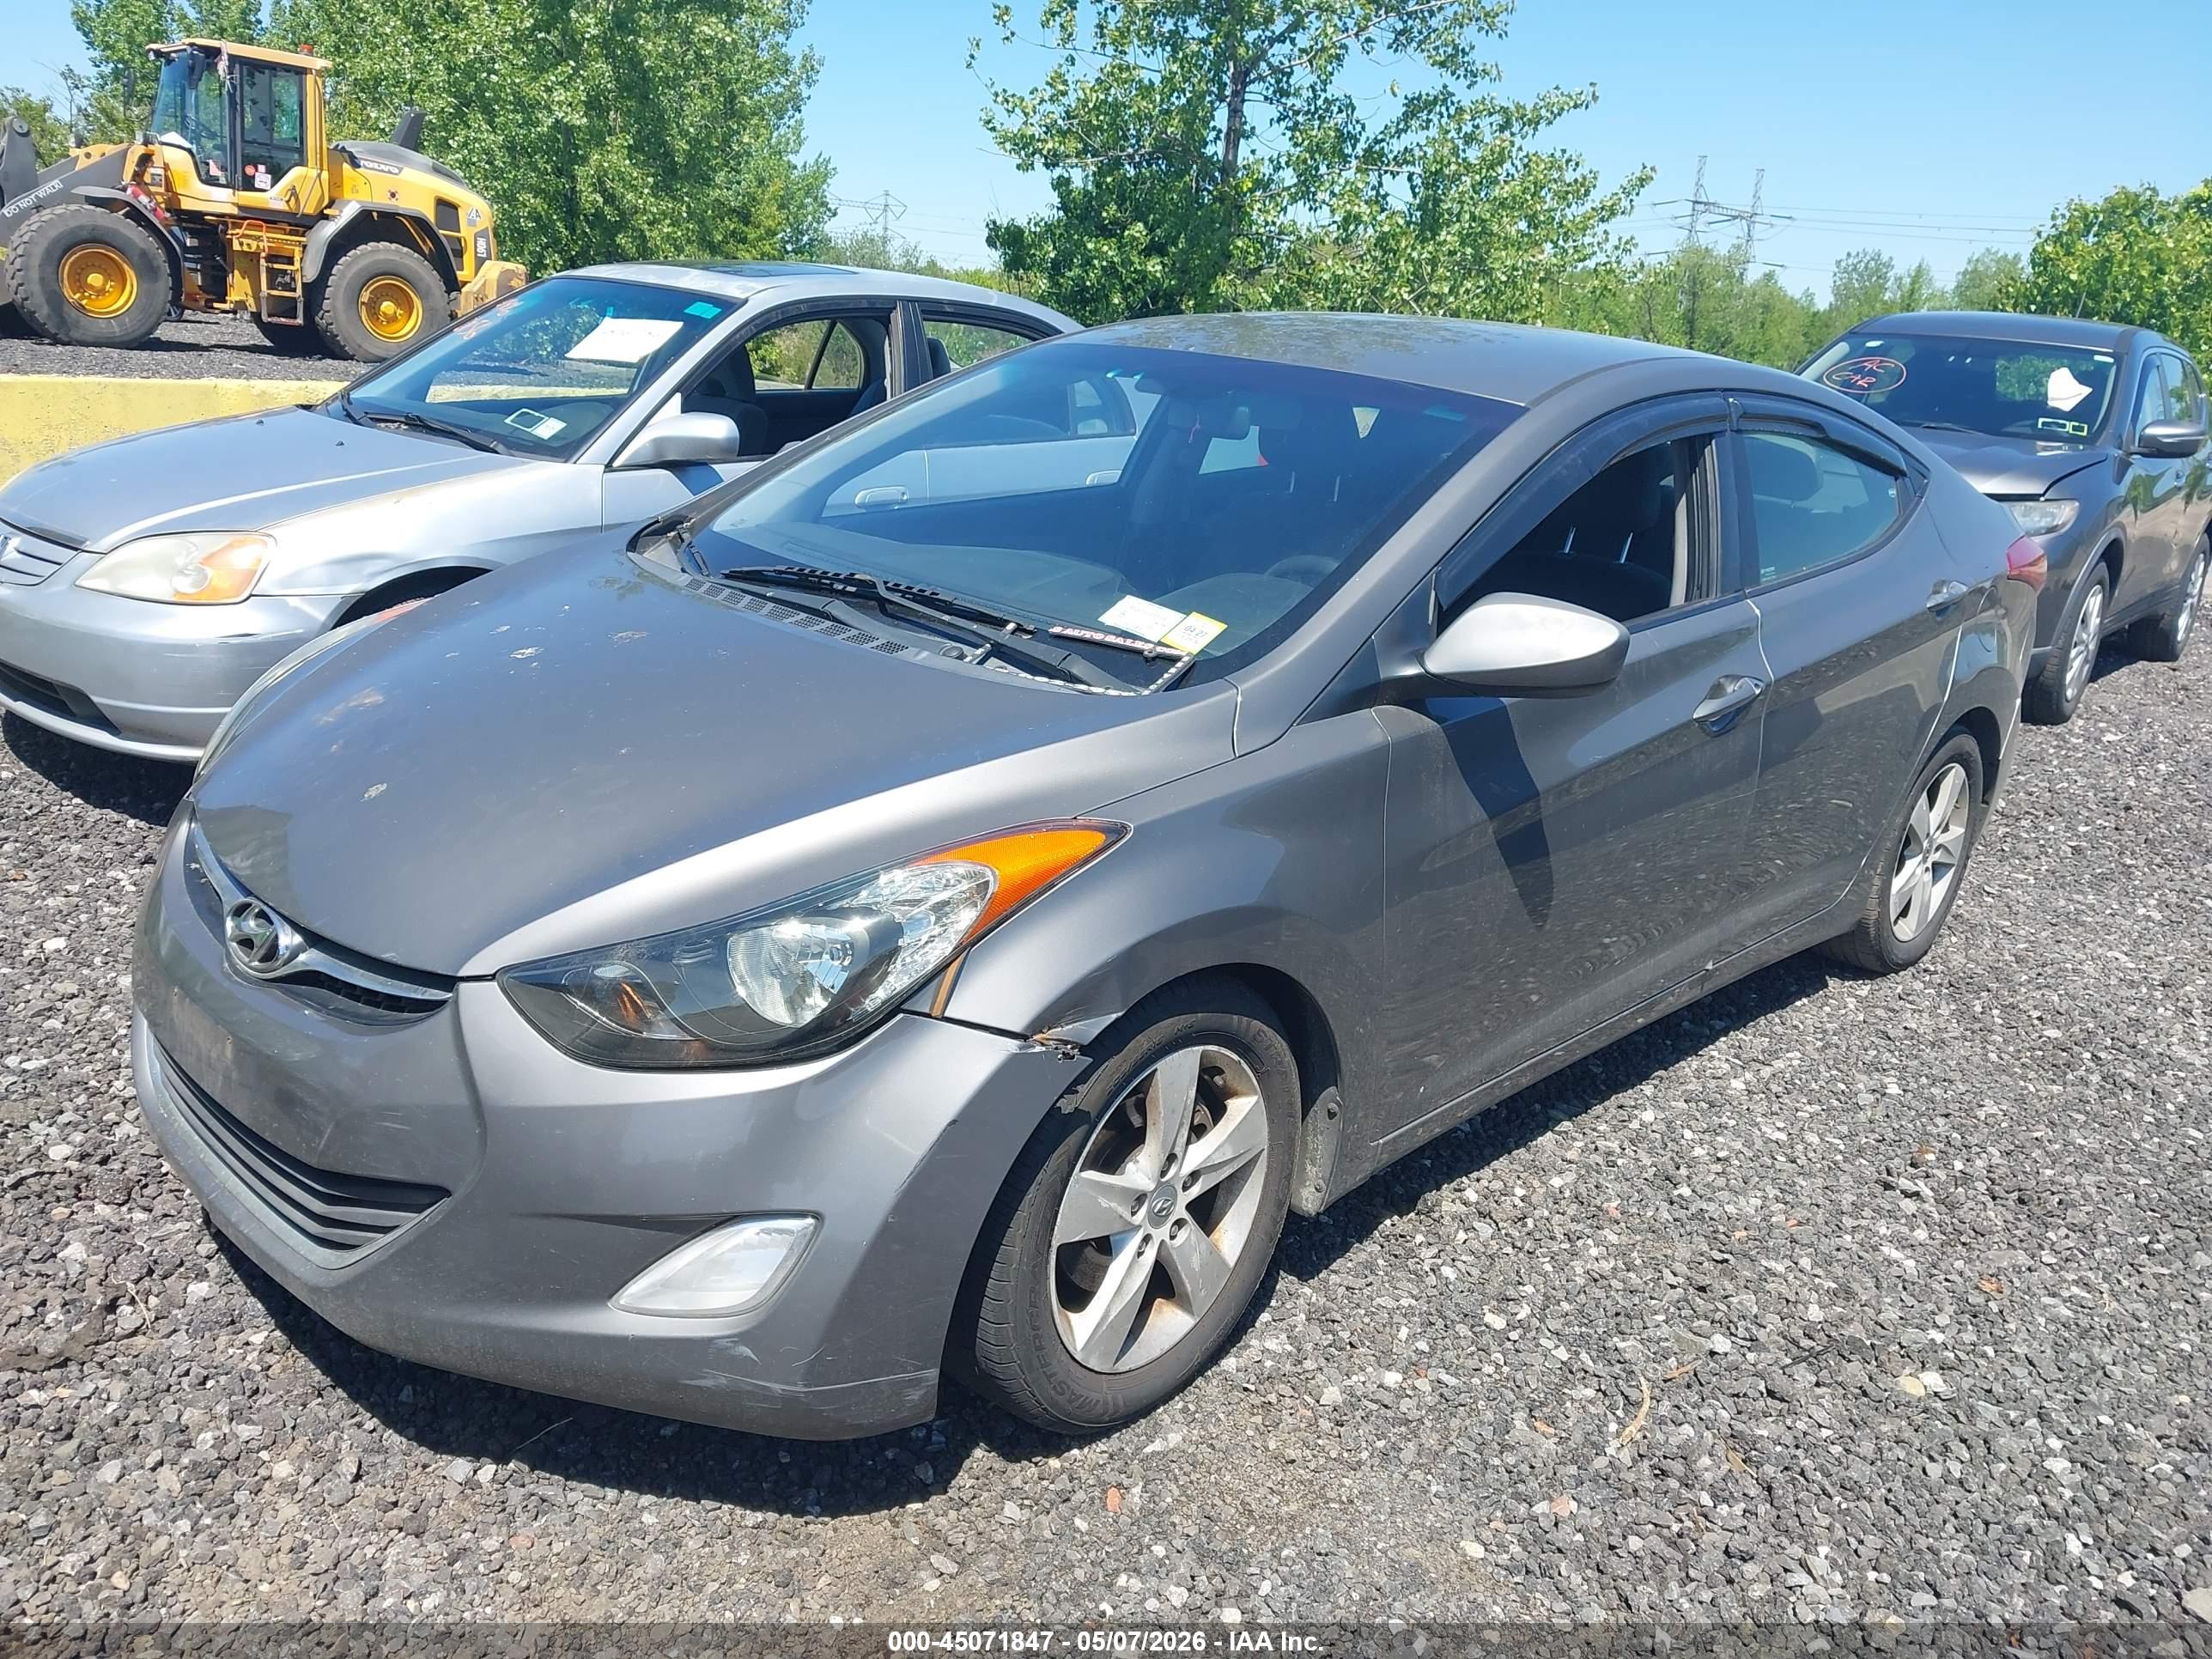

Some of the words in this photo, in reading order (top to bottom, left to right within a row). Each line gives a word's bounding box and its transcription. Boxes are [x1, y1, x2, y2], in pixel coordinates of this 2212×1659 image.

[3, 206, 19, 218] DO
[18, 195, 38, 210] NOT
[477, 237, 487, 258] L90H
